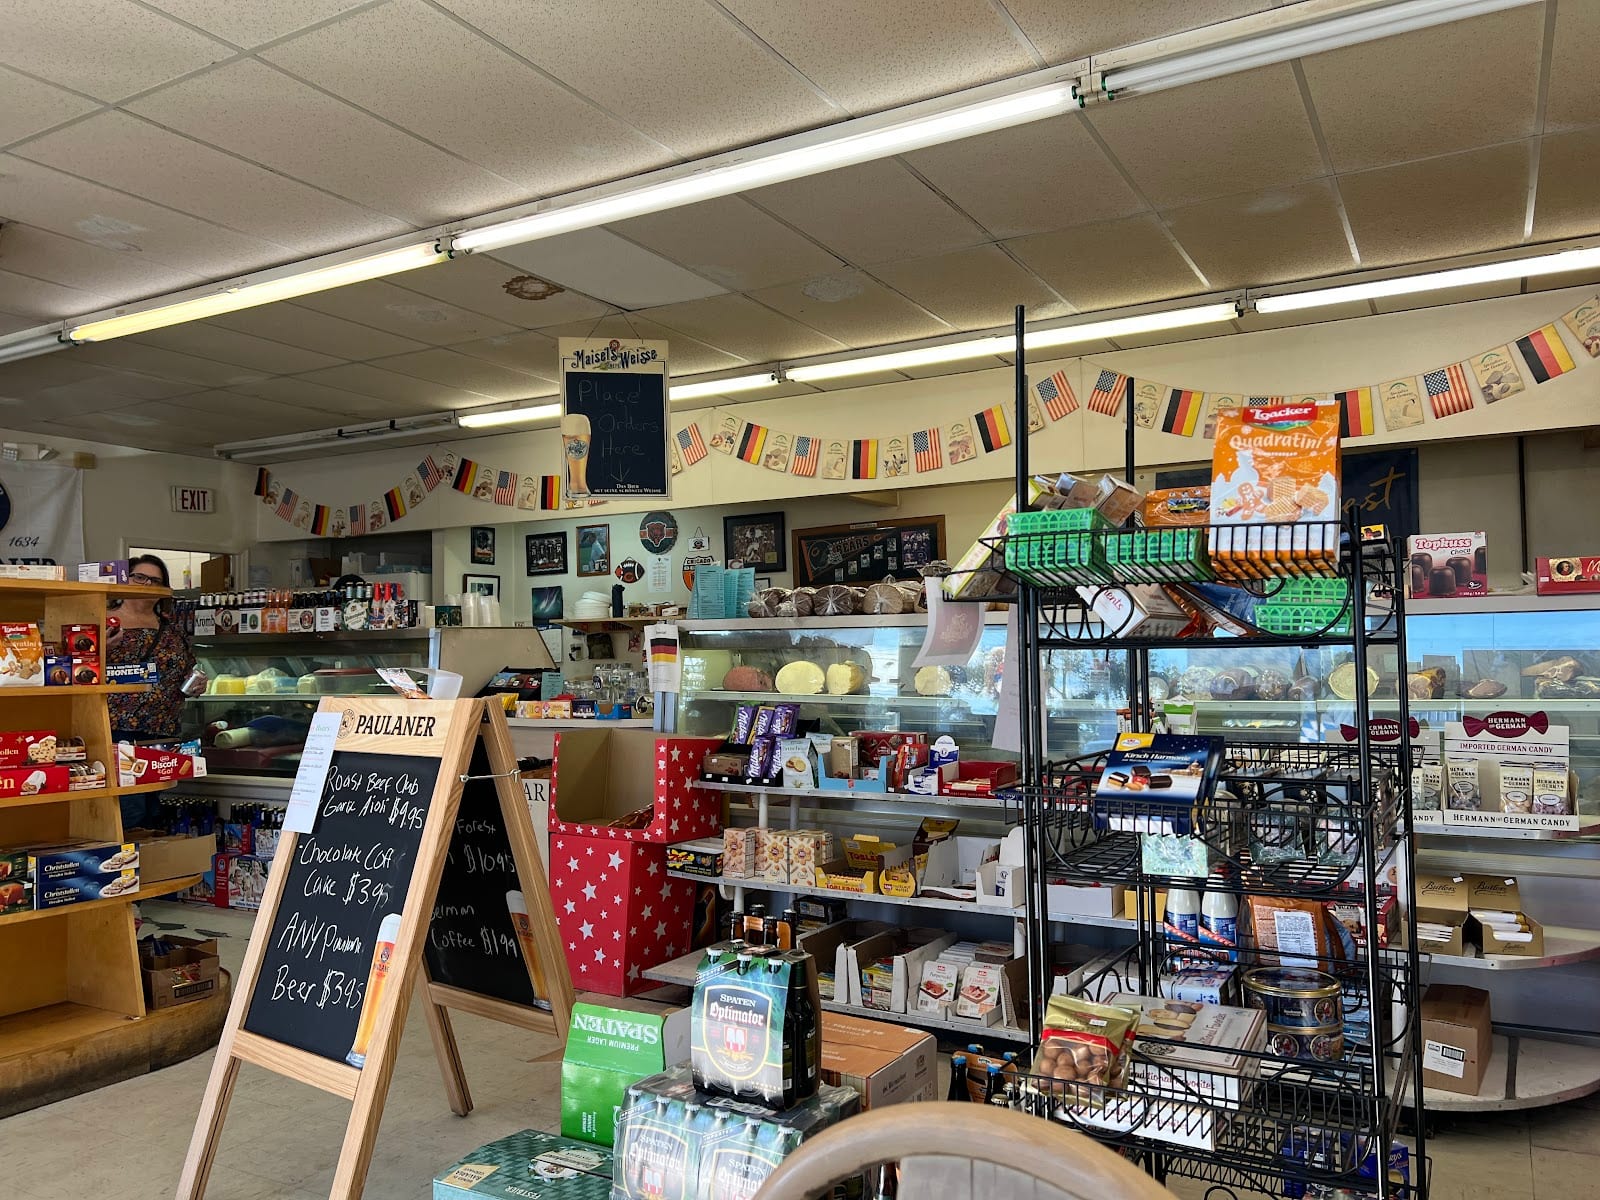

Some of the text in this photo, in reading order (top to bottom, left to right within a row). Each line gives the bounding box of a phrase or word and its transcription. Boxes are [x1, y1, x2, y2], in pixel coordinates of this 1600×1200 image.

[571, 347, 658, 369] Maisel's Weisse
[1250, 406, 1312, 421] Loacker
[1229, 432, 1323, 450] Quadratini
[181, 490, 208, 511] EXIT
[9, 536, 40, 548] 1634
[1415, 536, 1472, 551] Topkuss
[355, 715, 436, 737] PAULANER
[738, 711, 748, 739] Milka
[1124, 752, 1149, 760] Kirsch
[1460, 743, 1554, 754] IMPORTED GERMAN CANDY
[151, 757, 178, 770] Biscoff
[749, 749, 760, 778] Milka
[323, 766, 419, 796] Roast Beef Club
[388, 796, 425, 831] $9.95
[1453, 813, 1496, 822] HERMANN
[1503, 816, 1539, 825] GERMAN
[1541, 818, 1571, 827] CANDY
[456, 818, 496, 835] Forest
[304, 868, 337, 897] Cake
[277, 911, 326, 959] ANY
[431, 928, 476, 951] Coffee
[271, 964, 318, 1003] Beer
[719, 993, 757, 1008] SPATEN
[709, 1001, 765, 1027] Optimator
[572, 1012, 660, 1046] SPATEN
[586, 1035, 640, 1052] PREMIUM LAGER
[504, 1185, 542, 1200] FESTBIER
